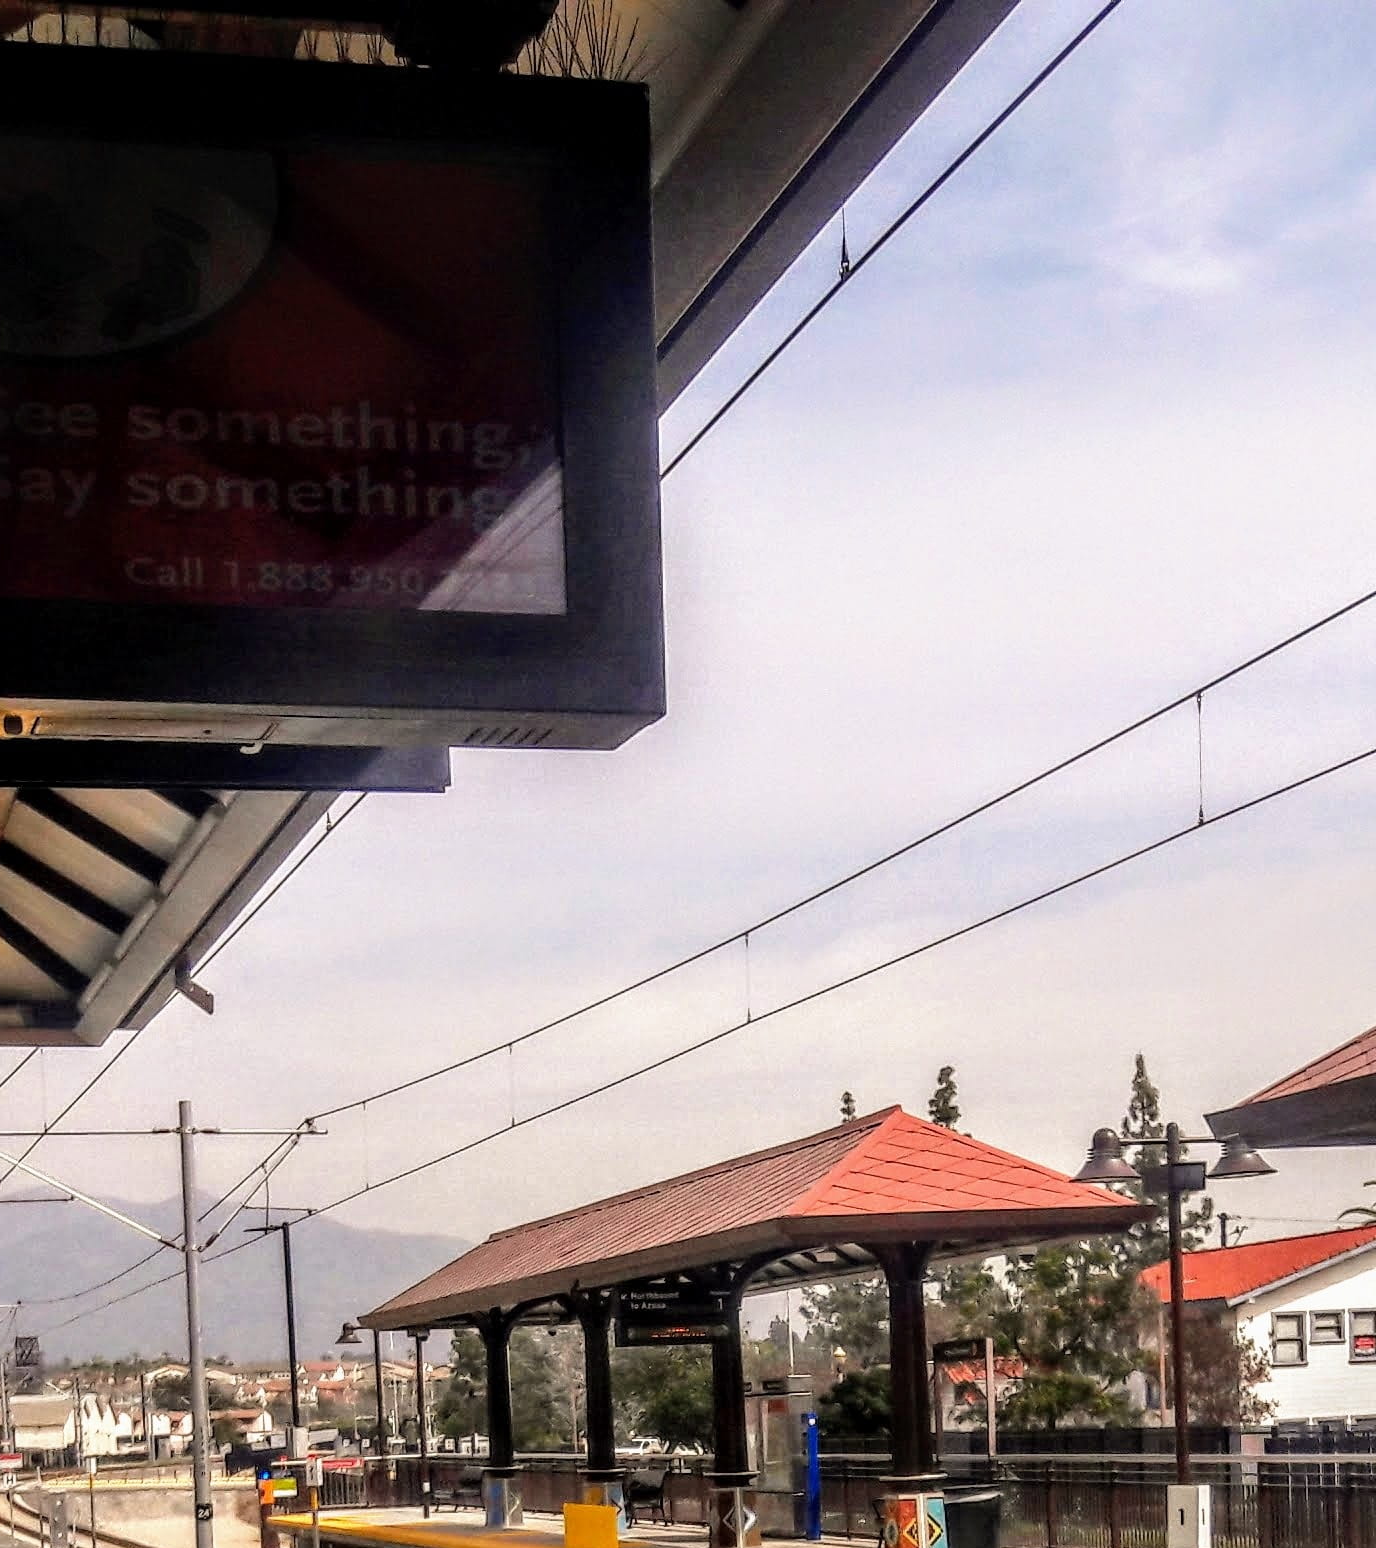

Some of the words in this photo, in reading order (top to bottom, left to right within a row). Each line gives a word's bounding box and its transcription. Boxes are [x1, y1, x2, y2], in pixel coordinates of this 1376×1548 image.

[128, 401, 532, 469] something,
[125, 556, 204, 590] Call
[1178, 1508, 1184, 1525] 1
